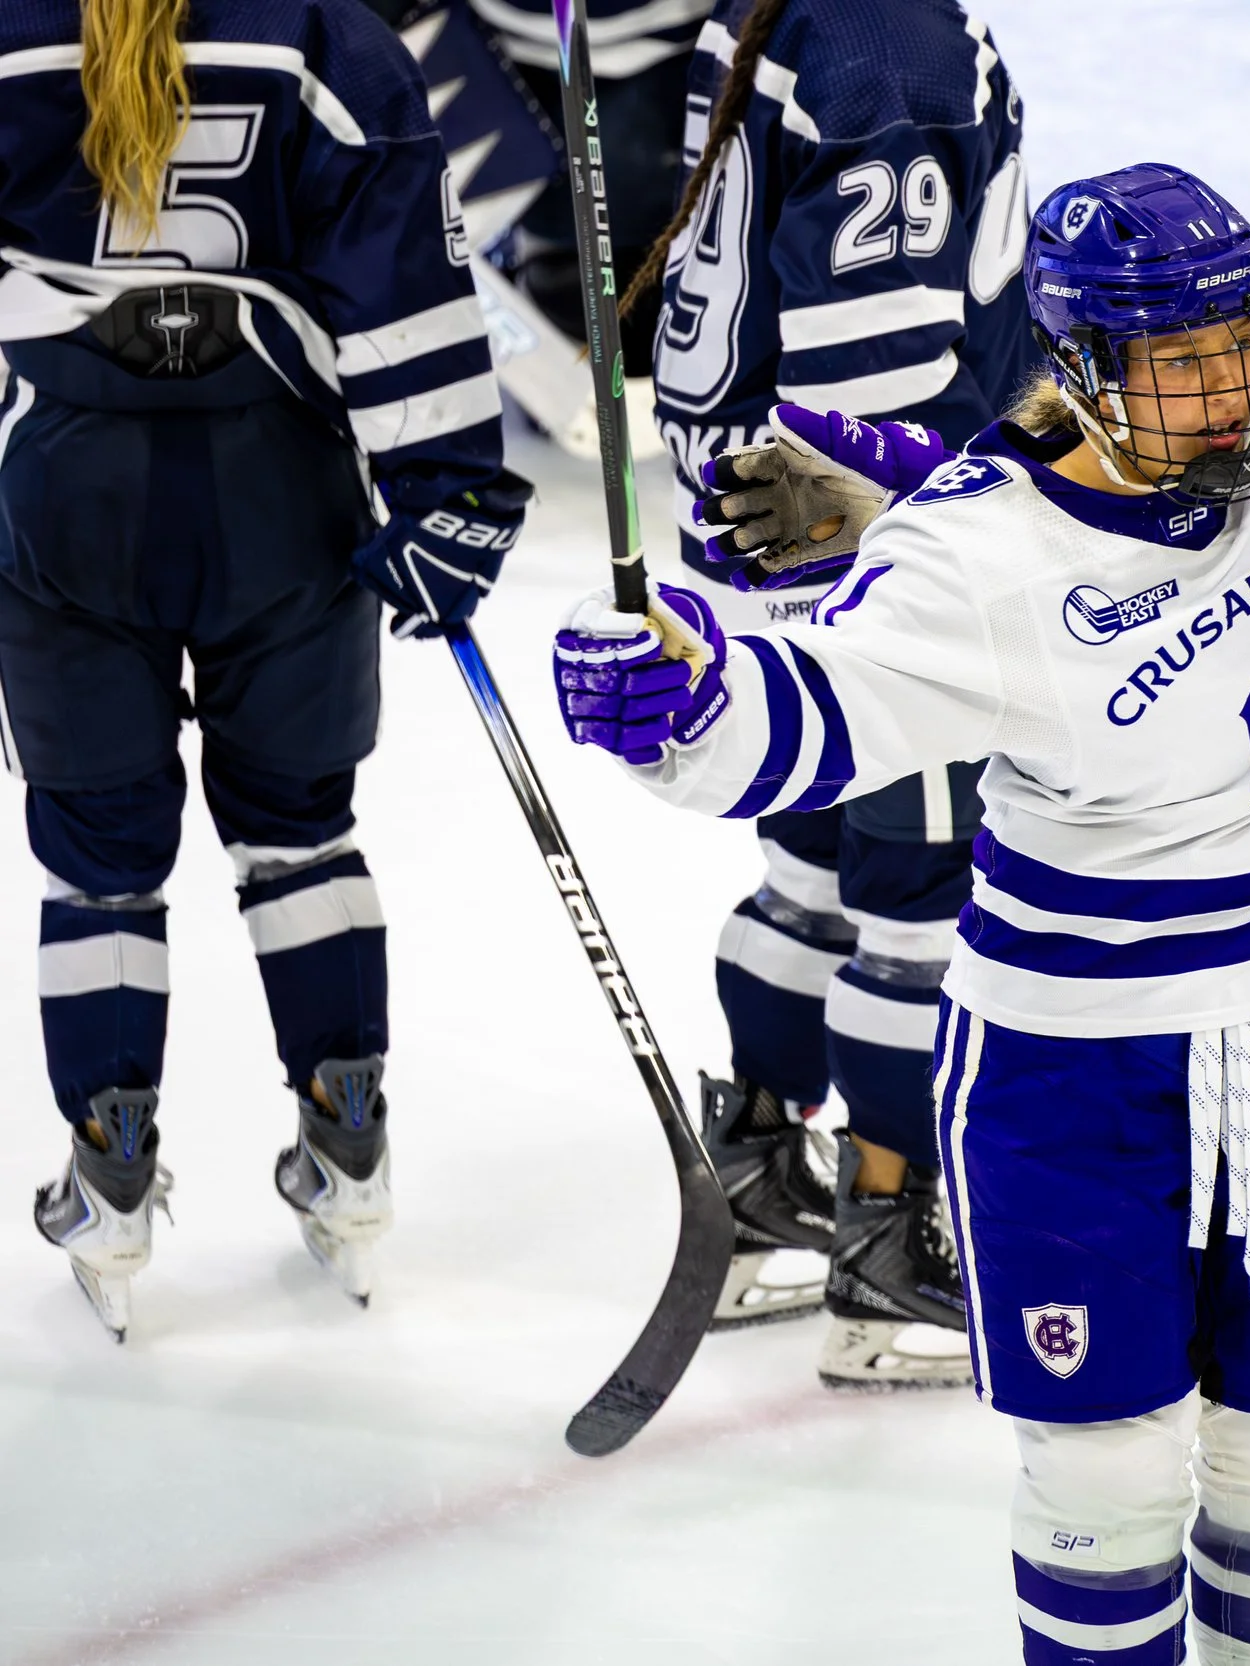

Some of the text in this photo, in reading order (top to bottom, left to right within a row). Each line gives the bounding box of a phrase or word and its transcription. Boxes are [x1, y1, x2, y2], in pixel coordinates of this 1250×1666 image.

[587, 136, 616, 296] BAUER
[833, 156, 951, 275] 29
[1188, 223, 1216, 240] 11
[1041, 282, 1083, 300] BAUER
[656, 420, 775, 492] OKI
[420, 509, 523, 551] BAU
[1168, 507, 1207, 537] SP
[1116, 582, 1174, 616] HOCKEY
[1120, 603, 1156, 628] EAST
[683, 691, 726, 740] BAUER
[546, 854, 660, 1056] BAUER
[1050, 1531, 1095, 1551] SP
